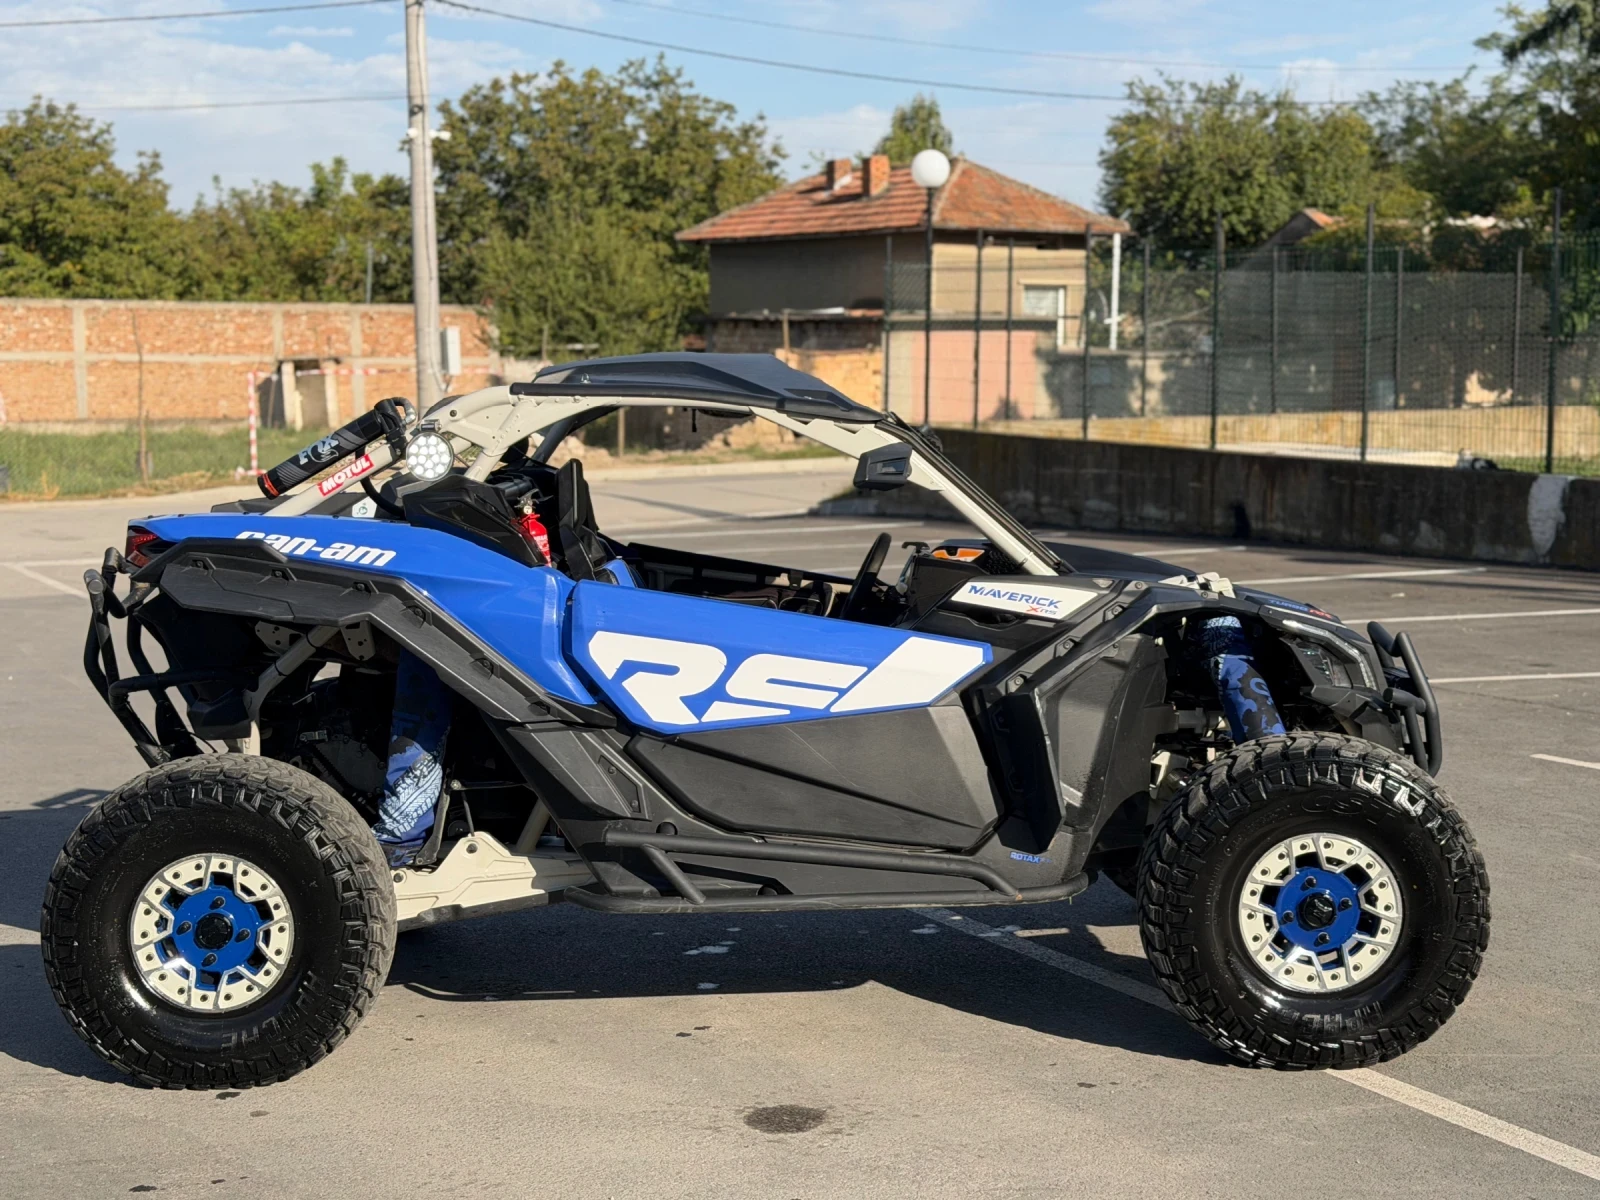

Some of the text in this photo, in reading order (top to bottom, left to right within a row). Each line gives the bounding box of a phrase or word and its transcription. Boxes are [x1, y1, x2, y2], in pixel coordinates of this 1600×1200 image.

[299, 434, 339, 465] FOX
[321, 458, 371, 494] MOTUL
[968, 585, 1062, 609] MAVERICK
[1010, 851, 1040, 864] ROTAX
